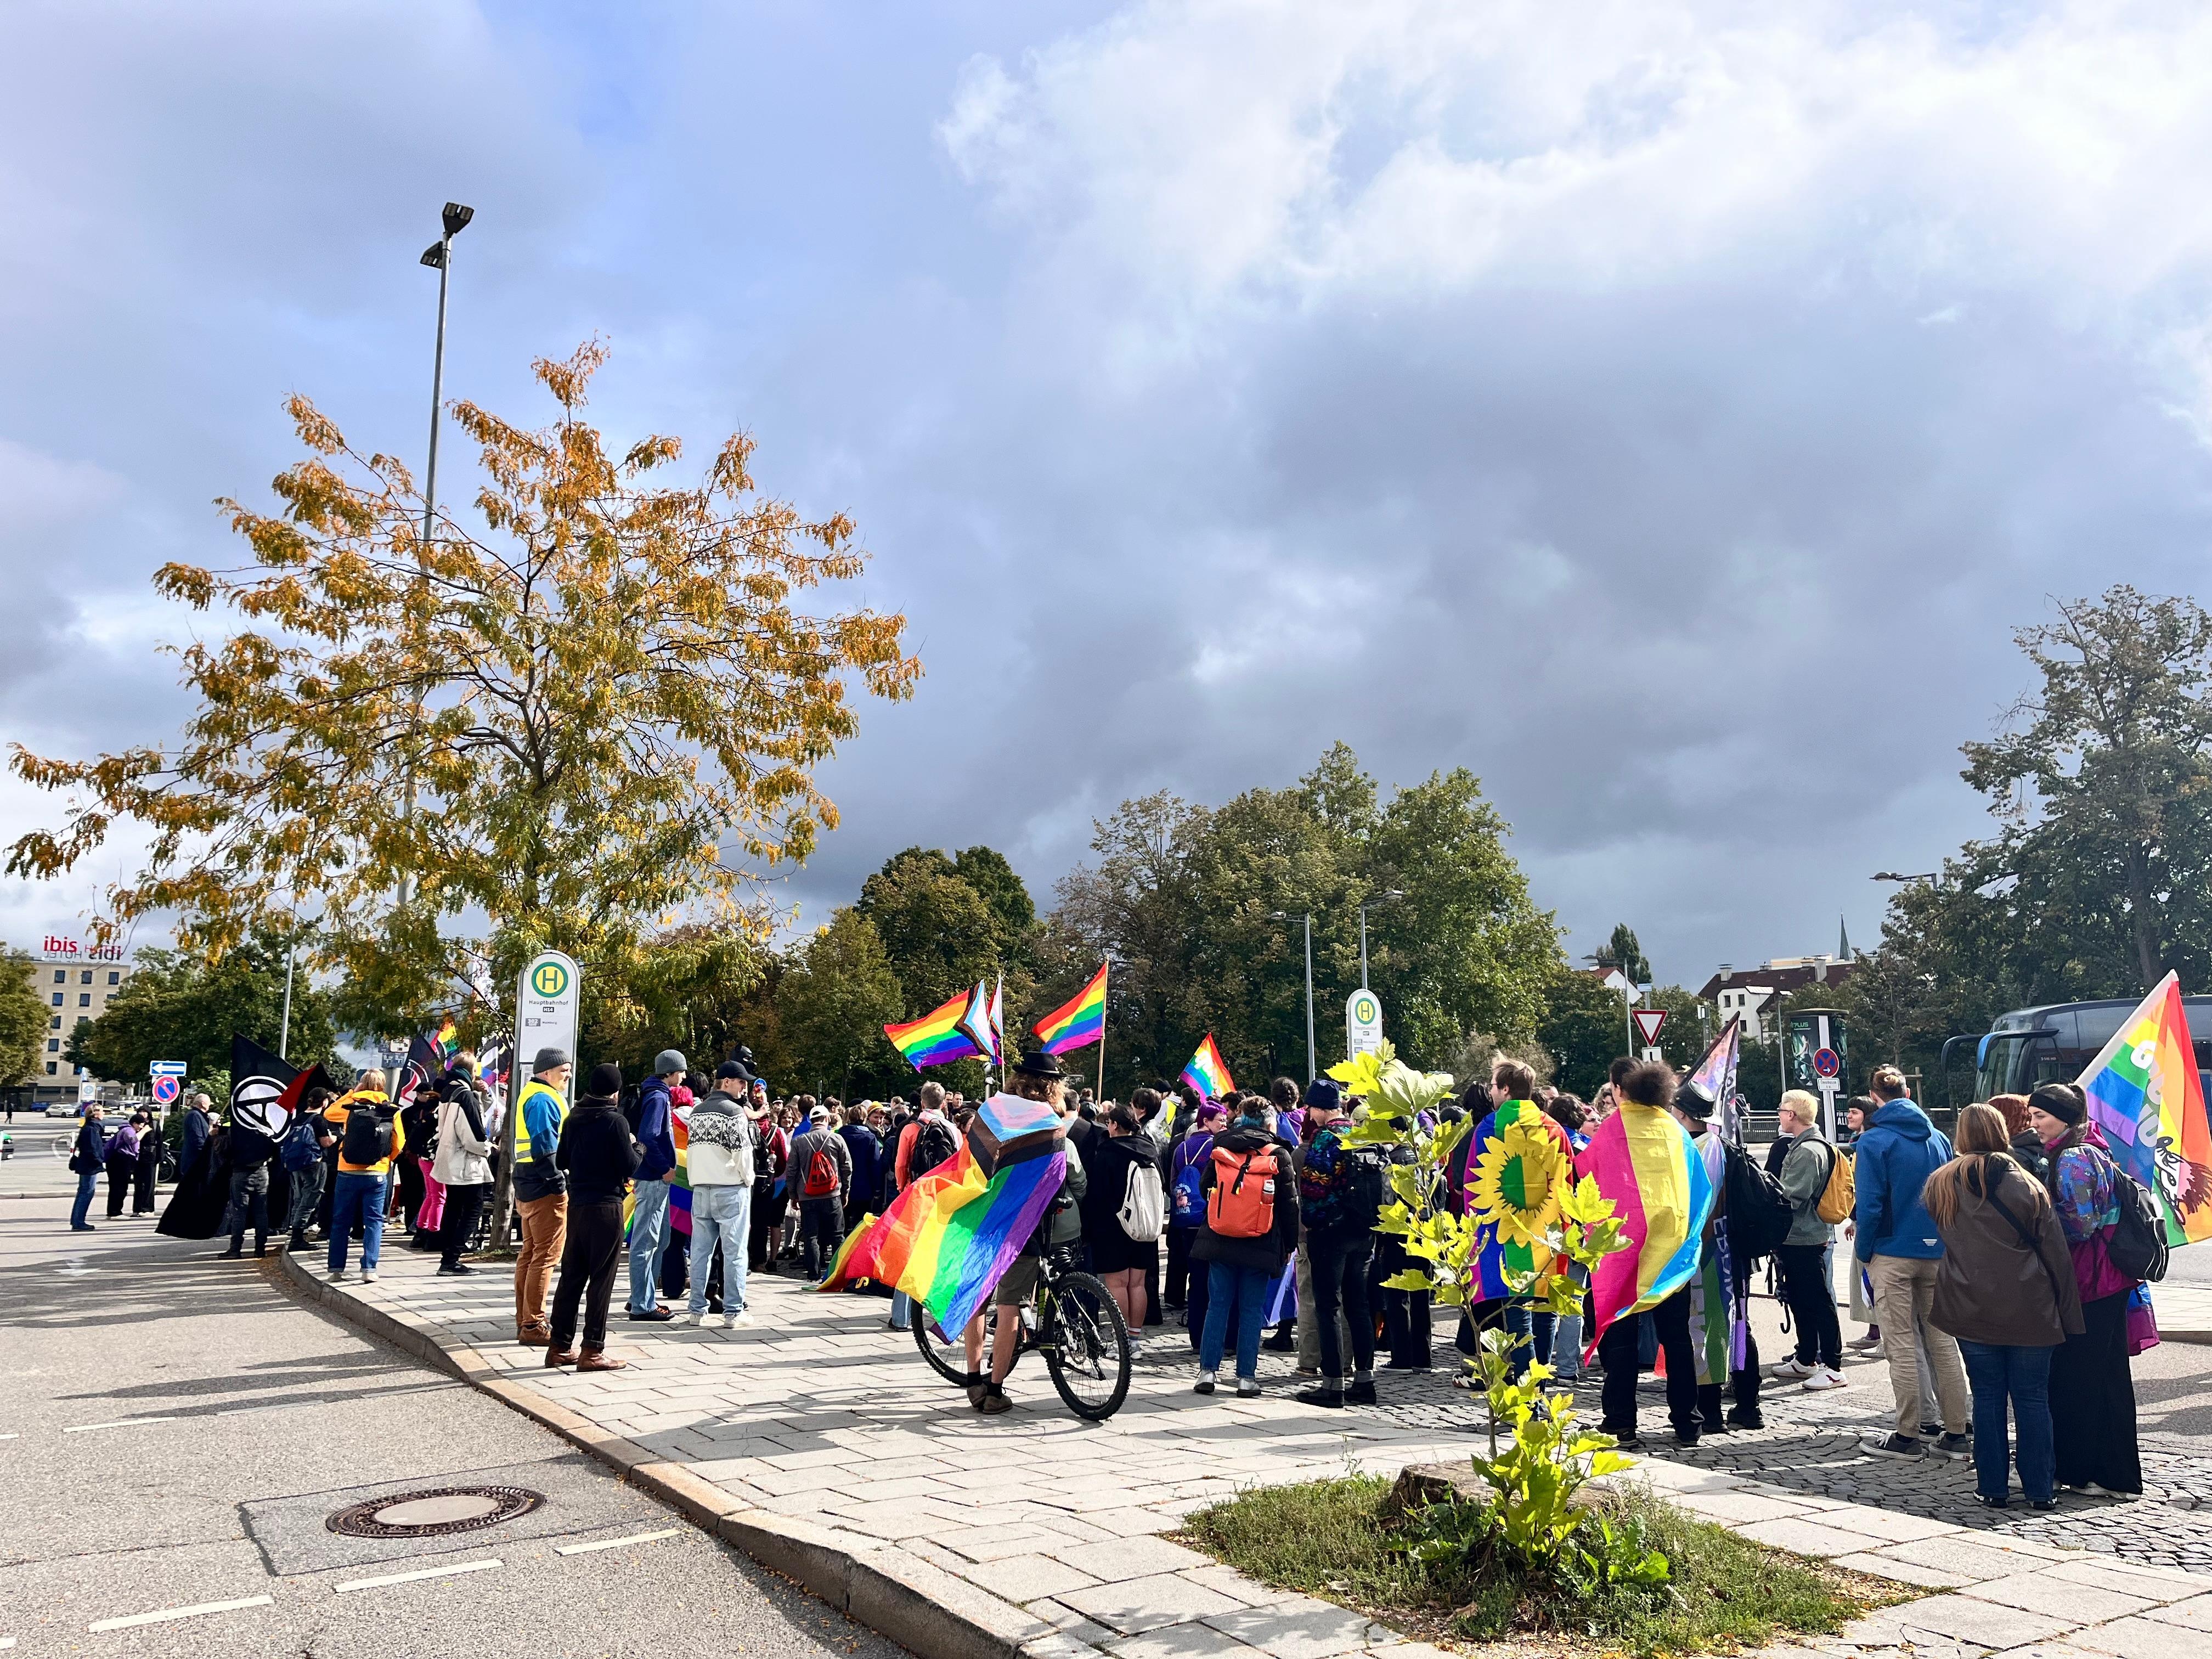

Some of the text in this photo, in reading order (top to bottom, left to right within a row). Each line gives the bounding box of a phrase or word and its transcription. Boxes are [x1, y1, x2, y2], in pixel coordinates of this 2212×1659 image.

[44, 935, 77, 952] ibis
[542, 969, 557, 990] H
[1361, 1003, 1370, 1019] H
